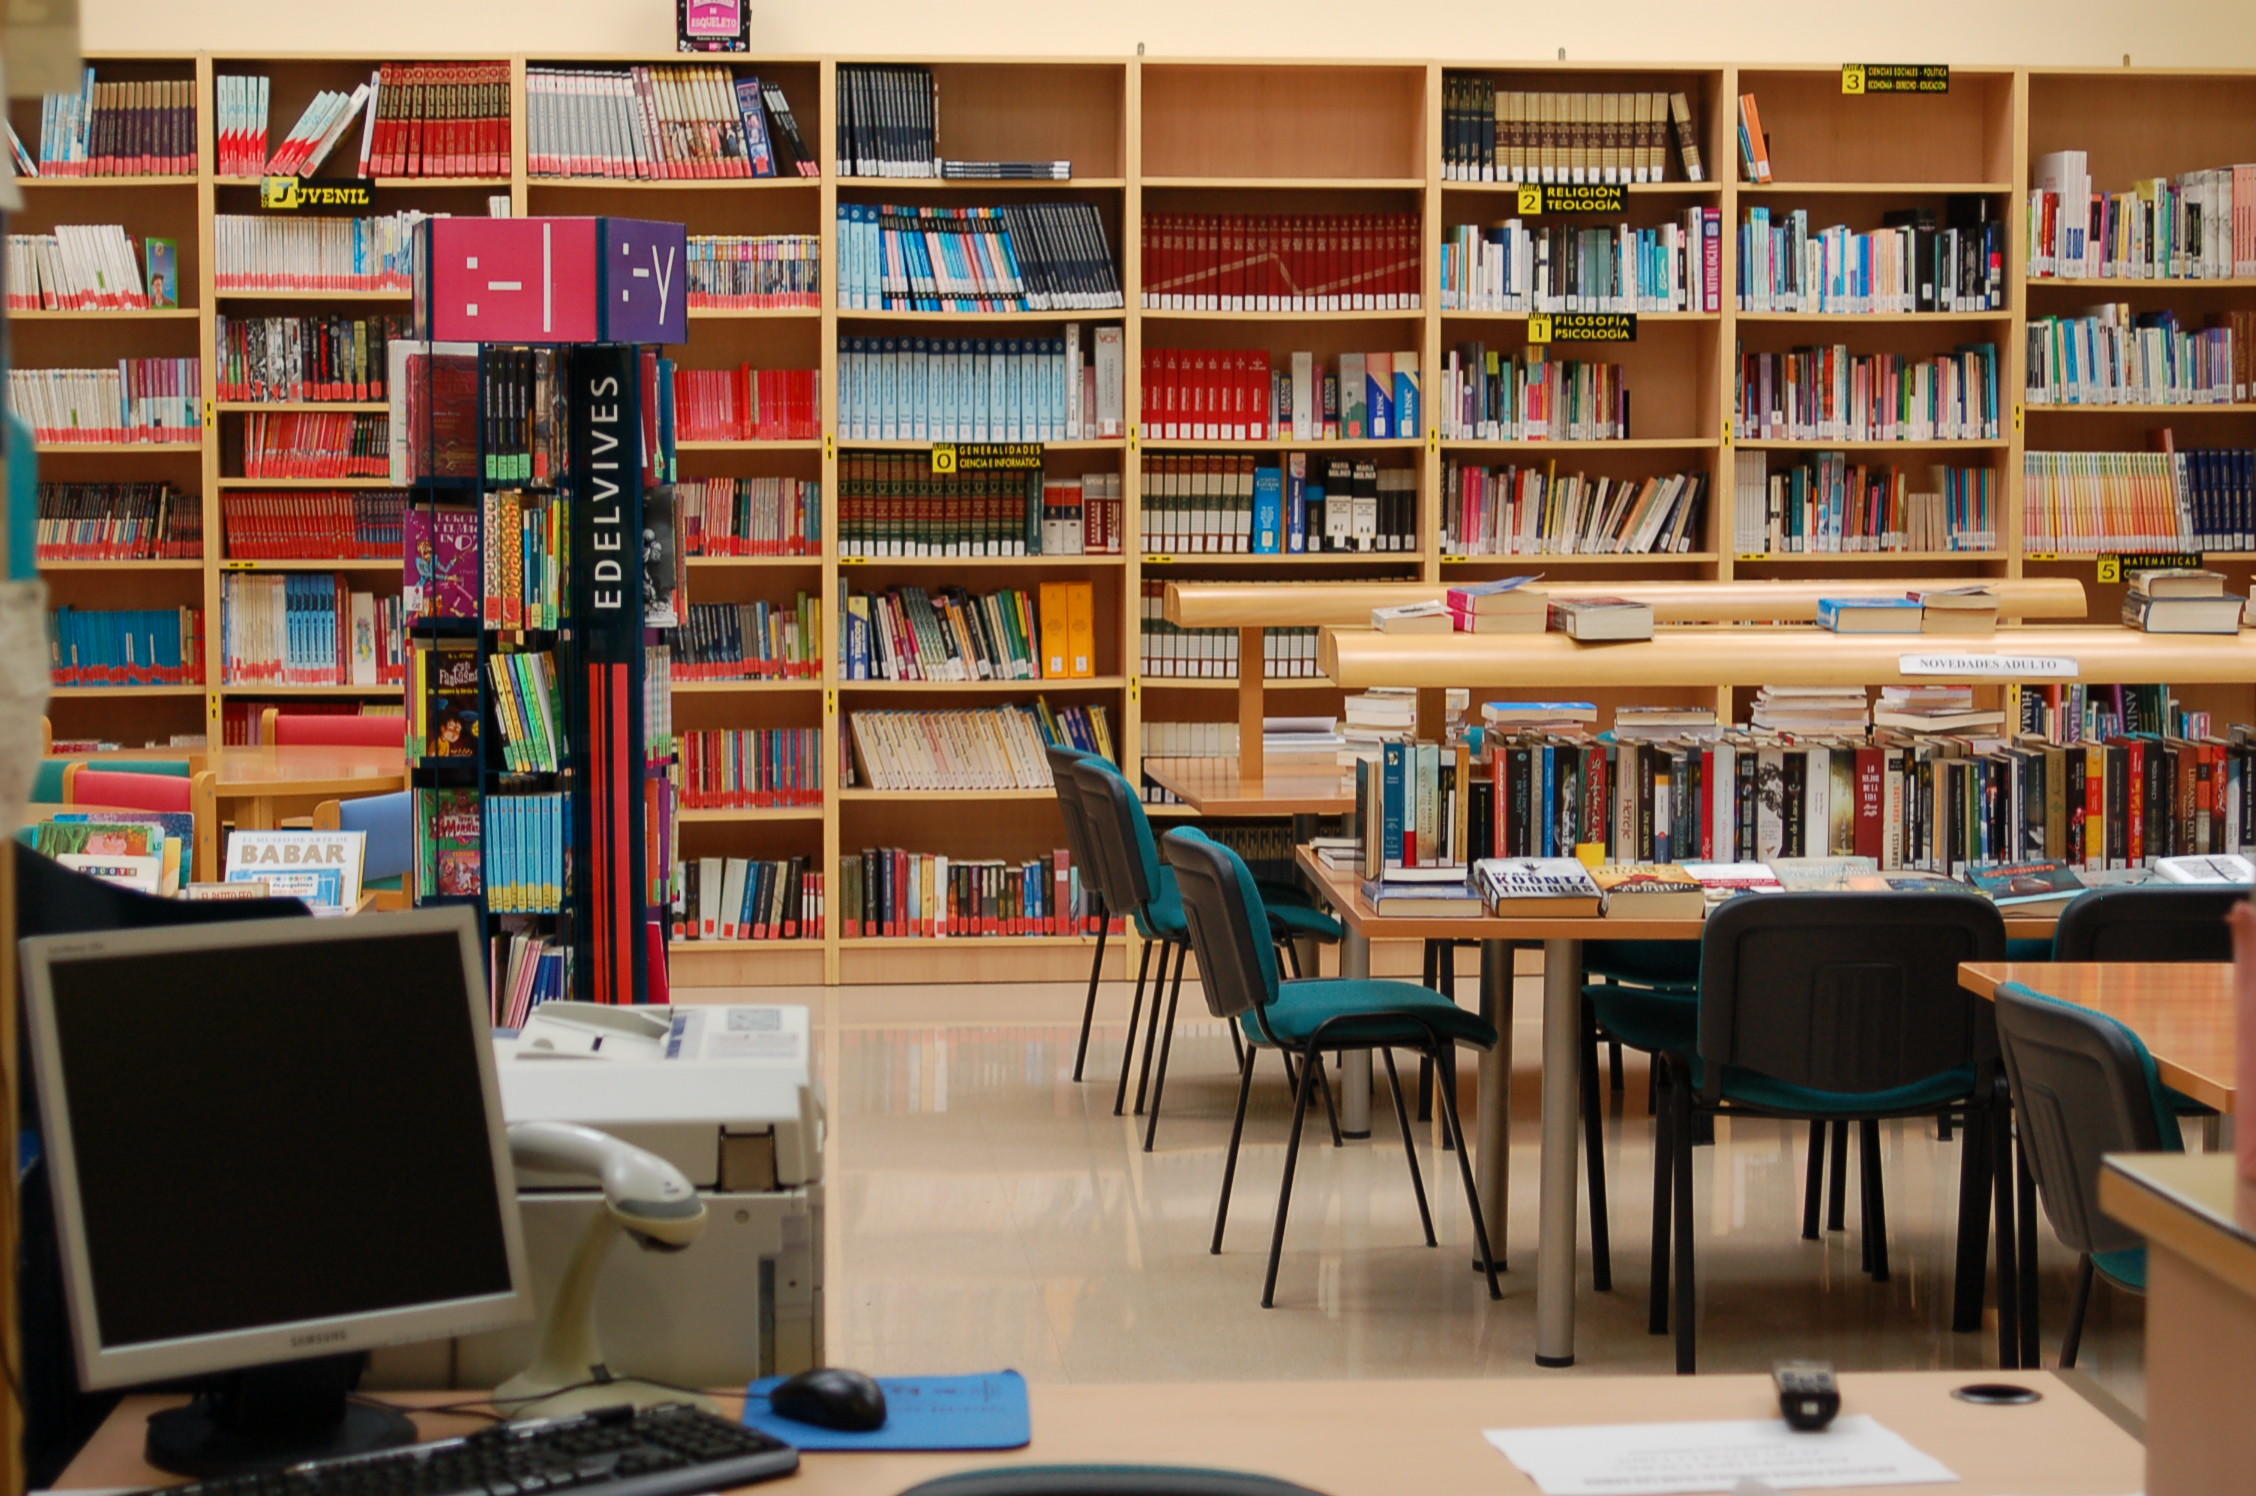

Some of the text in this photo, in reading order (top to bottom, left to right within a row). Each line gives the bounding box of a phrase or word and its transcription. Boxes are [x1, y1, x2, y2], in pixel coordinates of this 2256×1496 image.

[1846, 74, 1860, 90] 3
[1547, 186, 1621, 198] RELIGIÓN
[1523, 193, 1536, 211] 2
[1547, 198, 1621, 211] TEOLOGÍA
[1555, 316, 1630, 327] FILOSOFÍA
[1535, 323, 1543, 339] 1
[1555, 327, 1630, 339] PSICOLOGÍA
[959, 444, 1041, 456] GENERALIDADES
[959, 458, 987, 469] CIENCIA
[590, 376, 622, 609] EDELVIVES
[2123, 556, 2198, 567] MATEMÁTICAS
[2102, 563, 2115, 580] 5
[1920, 657, 2057, 671] NOVEDADES ADULTO
[240, 844, 346, 864] BABAR
[1495, 874, 1587, 885] KOONTZ
